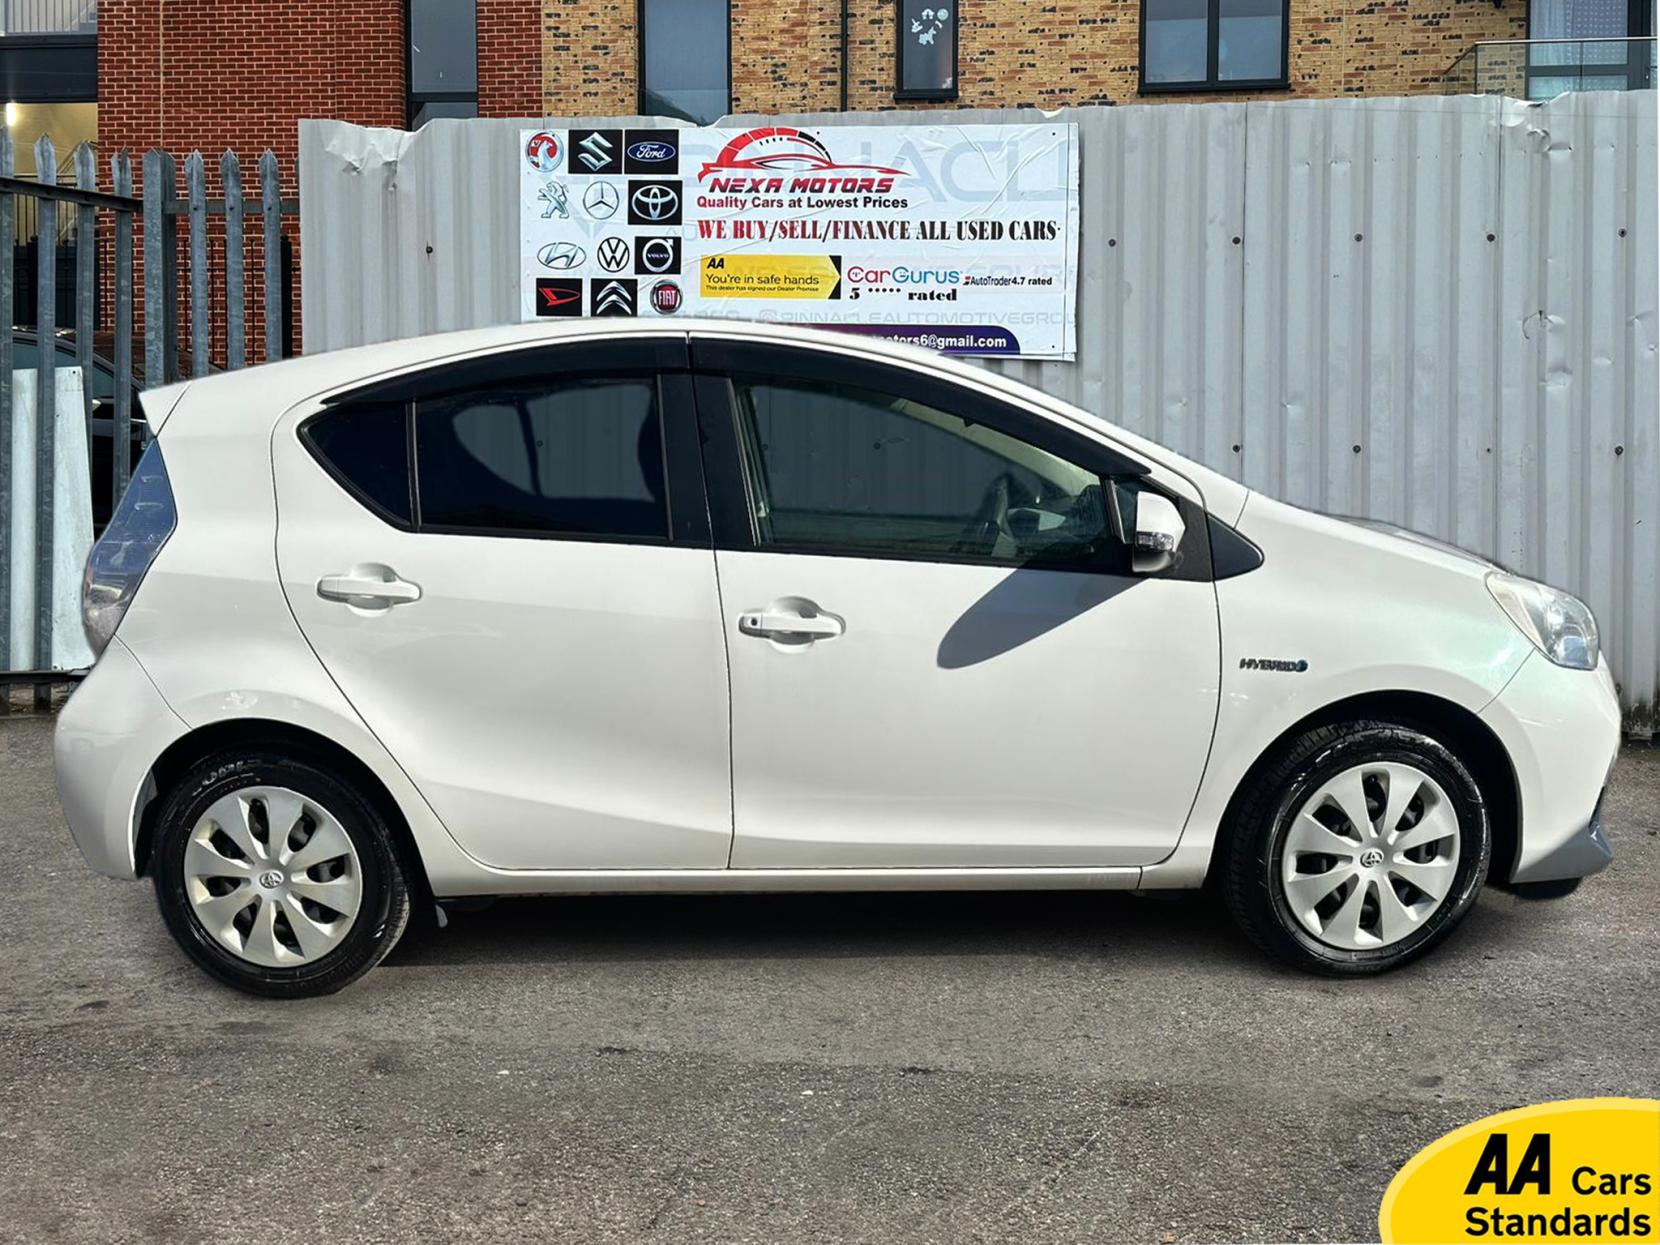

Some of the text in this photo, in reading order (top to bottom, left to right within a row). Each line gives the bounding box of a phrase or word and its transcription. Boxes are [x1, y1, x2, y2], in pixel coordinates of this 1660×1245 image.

[636, 144, 666, 159] Ford
[708, 177, 895, 193] NEXA MOTORS
[697, 196, 908, 210] Quality Cars at Lowest Prices
[697, 220, 726, 239] WE
[733, 220, 911, 242] BUY/SELL/FINANCE
[916, 220, 950, 240] ALL
[956, 220, 1004, 240] USED
[1008, 220, 1057, 241] CARS
[706, 257, 725, 269] AA
[706, 273, 820, 285] You're in safe hands
[847, 265, 960, 284] CarGurus
[1028, 276, 1053, 285] rated
[658, 290, 677, 306] FIAT
[849, 287, 957, 301] 5 rated
[1239, 658, 1297, 672] HYBRID
